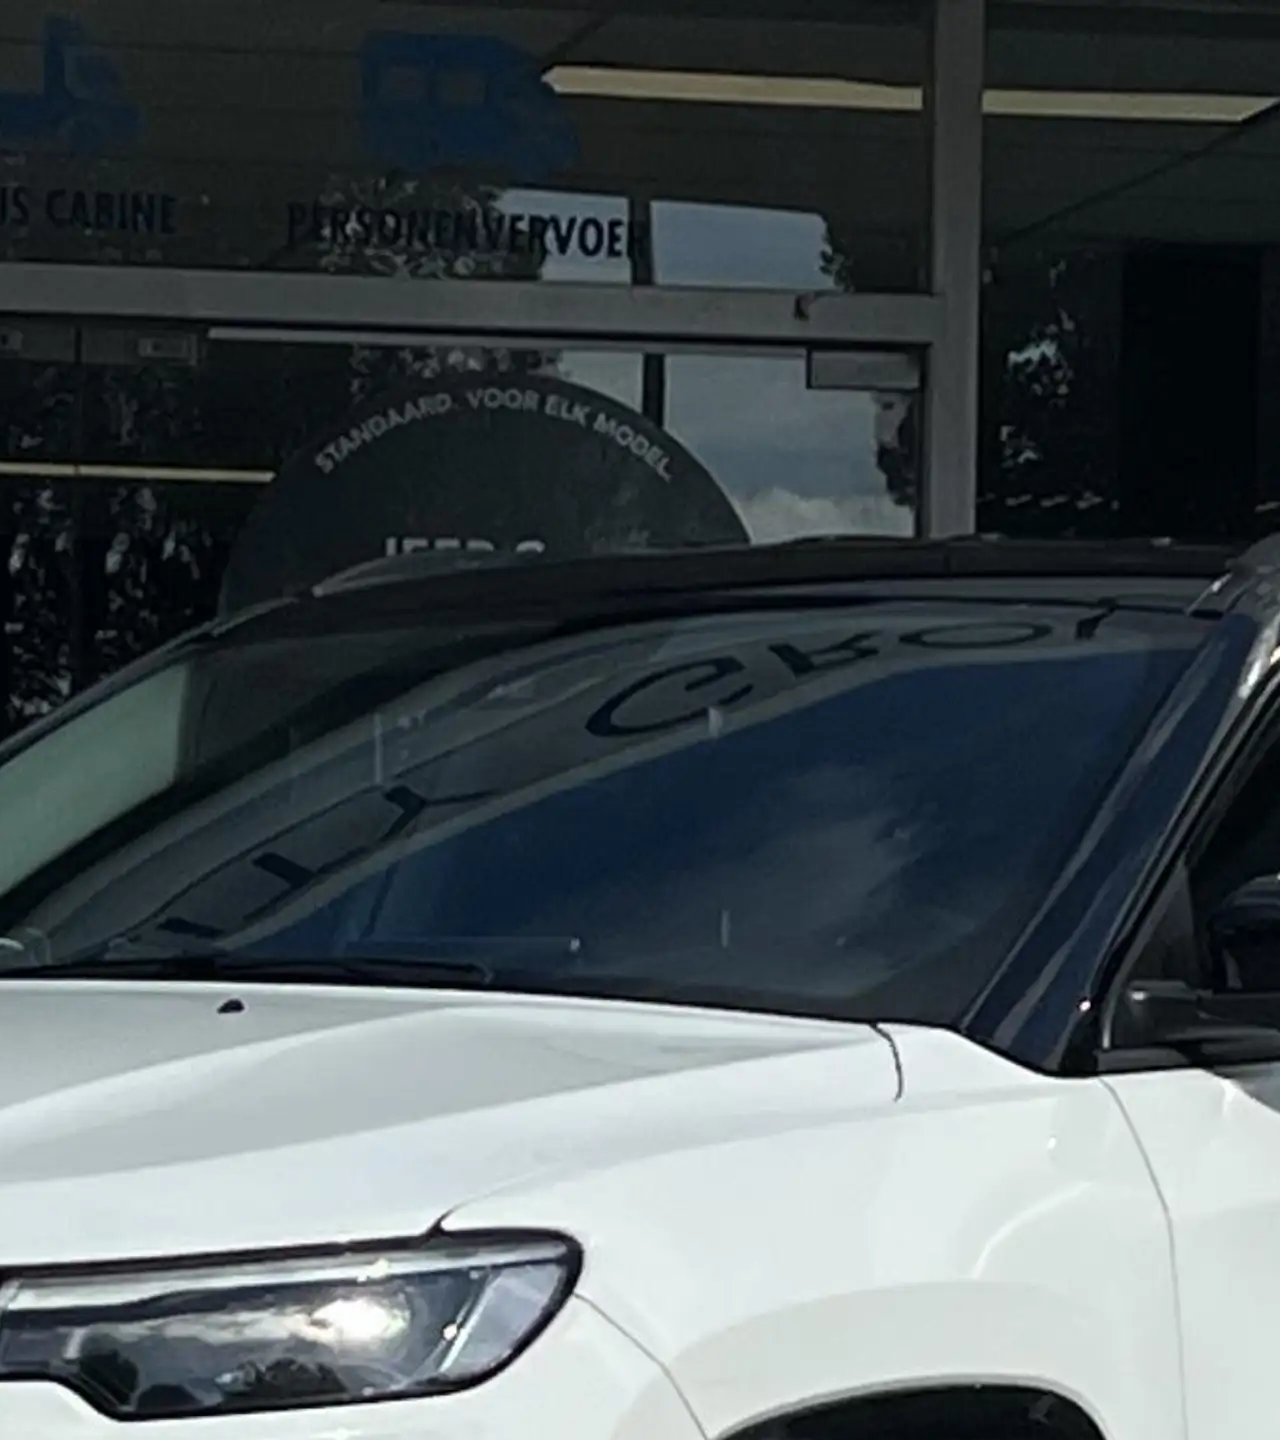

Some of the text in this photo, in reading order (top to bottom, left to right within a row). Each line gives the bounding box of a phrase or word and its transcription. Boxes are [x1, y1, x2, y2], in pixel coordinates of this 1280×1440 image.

[45, 188, 180, 235] CABINE
[465, 387, 540, 413] VOOR
[544, 394, 592, 429] ELK
[592, 411, 673, 484] MODEL
